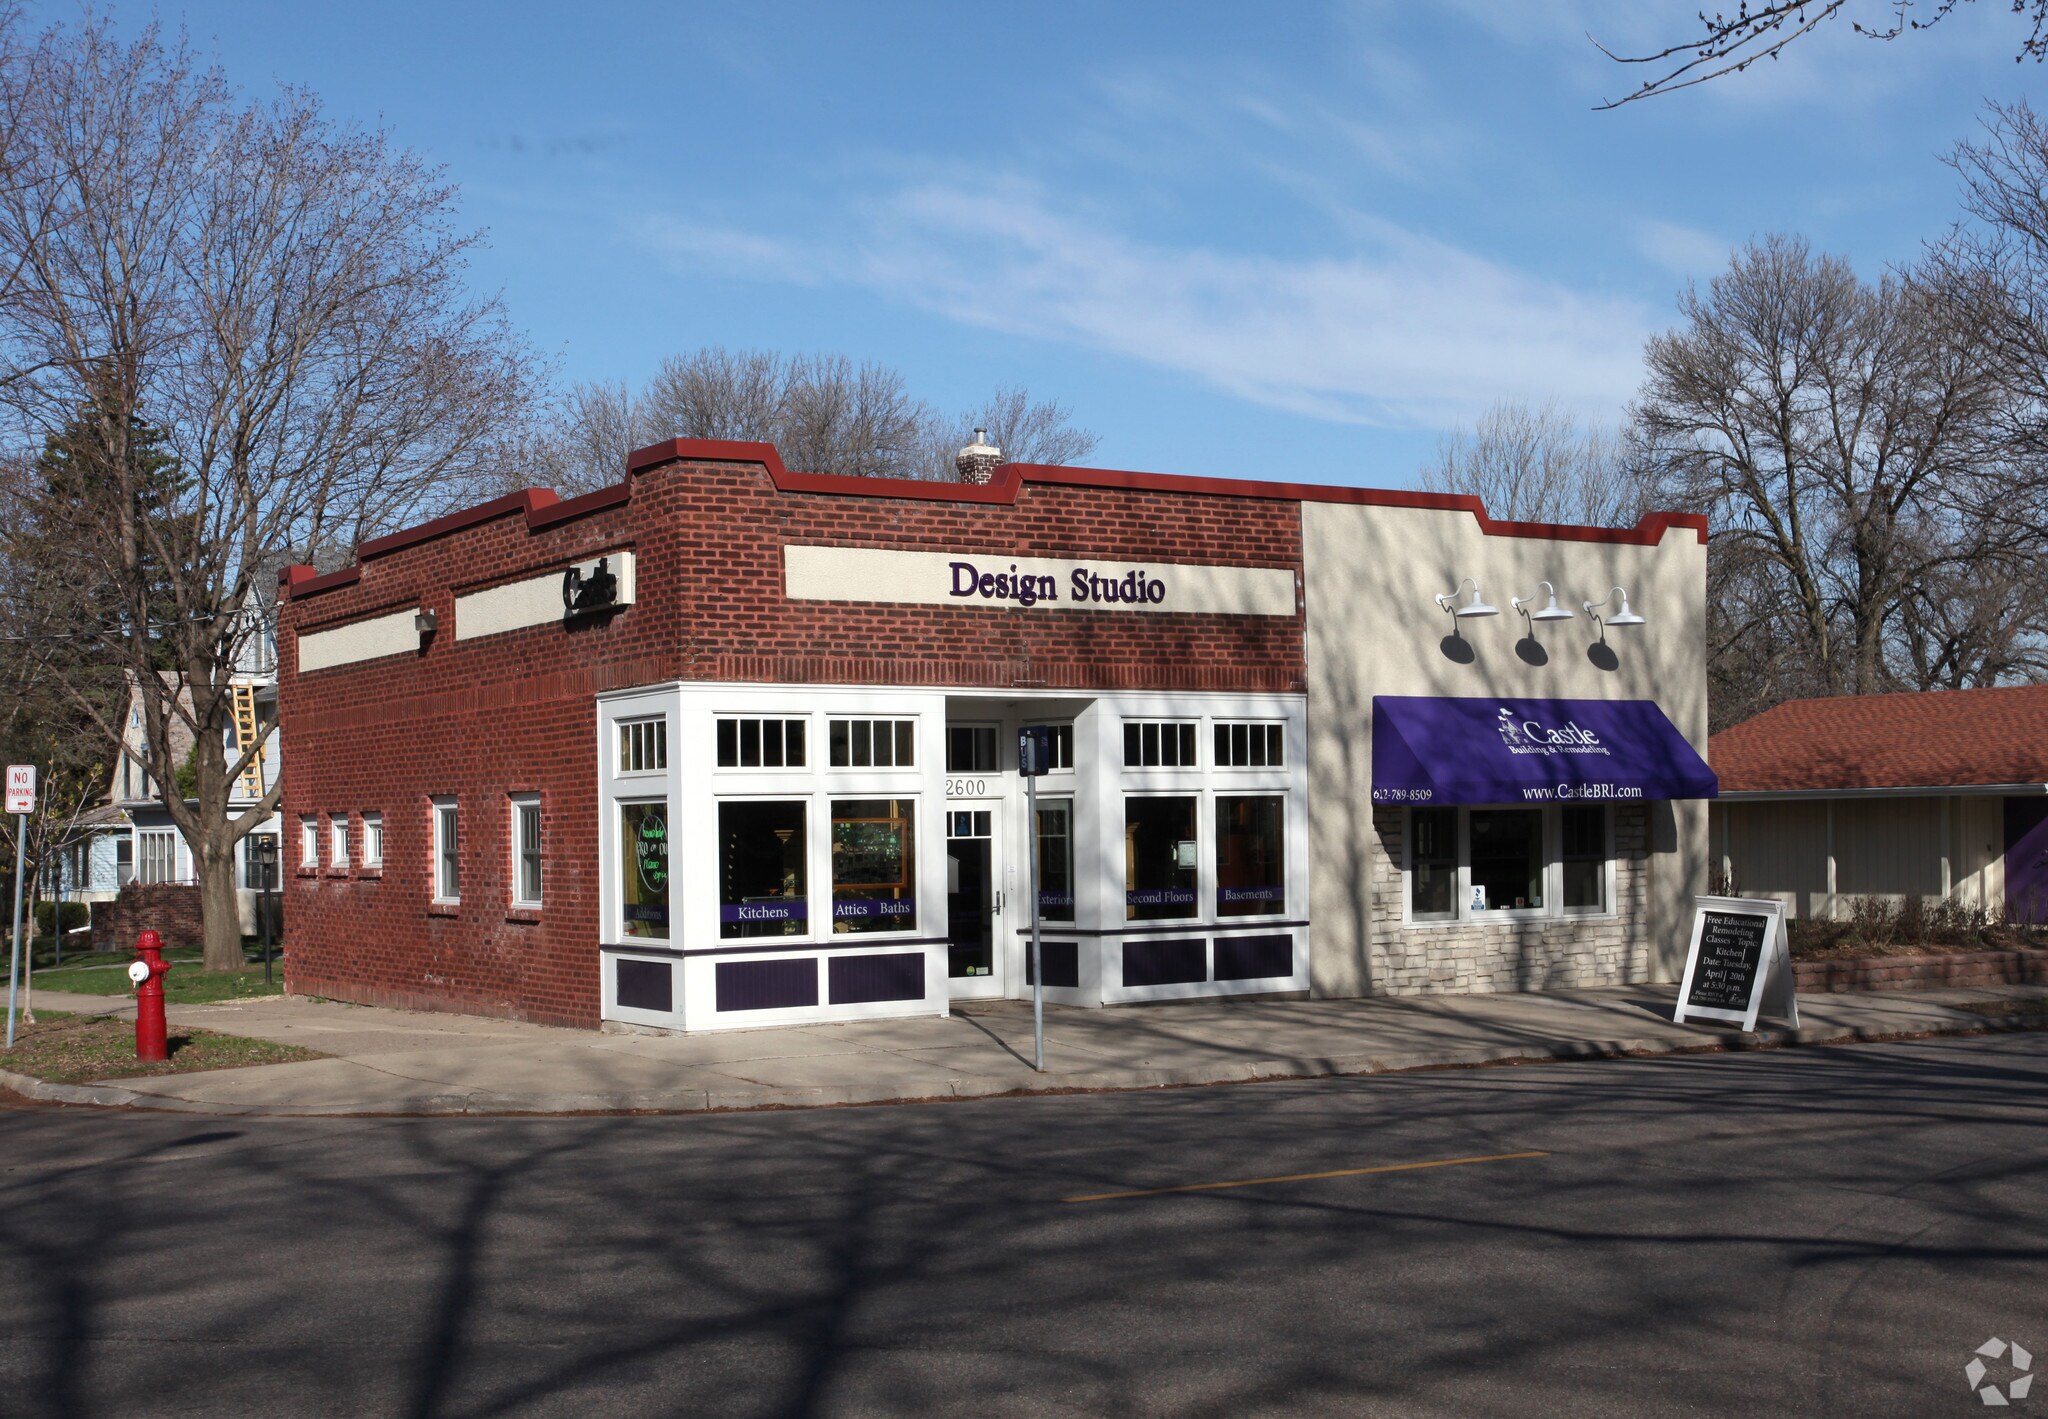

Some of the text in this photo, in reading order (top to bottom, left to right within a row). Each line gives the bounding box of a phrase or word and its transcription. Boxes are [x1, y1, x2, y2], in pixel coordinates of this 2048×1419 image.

[949, 562, 1166, 607] Design Studio
[1522, 720, 1600, 745] Castle
[1020, 736, 1028, 769] BUS
[1508, 745, 1611, 756] Building & Remodeling
[14, 772, 28, 784] NO
[8, 788, 33, 797] PARKING
[945, 780, 985, 796] 2600
[1523, 783, 1643, 800] www.CastleBRI.com
[1373, 789, 1432, 801] 612-789-8509
[1127, 890, 1194, 905] Second Floors
[1225, 888, 1273, 901] Basements
[635, 907, 662, 920] Additions
[738, 907, 789, 920] Kitchens
[836, 902, 910, 916] Attics Baths
[1707, 915, 1765, 928] Free Educational
[1712, 926, 1754, 938] Remodeling
[1706, 934, 1731, 944] Classes
[1738, 938, 1758, 949] Topic:
[1716, 947, 1743, 957] Kitchen
[1703, 956, 1721, 966] Date:
[1705, 969, 1745, 981] April 20th
[1711, 981, 1726, 990] 5:30
[1726, 984, 1742, 993] p.m.
